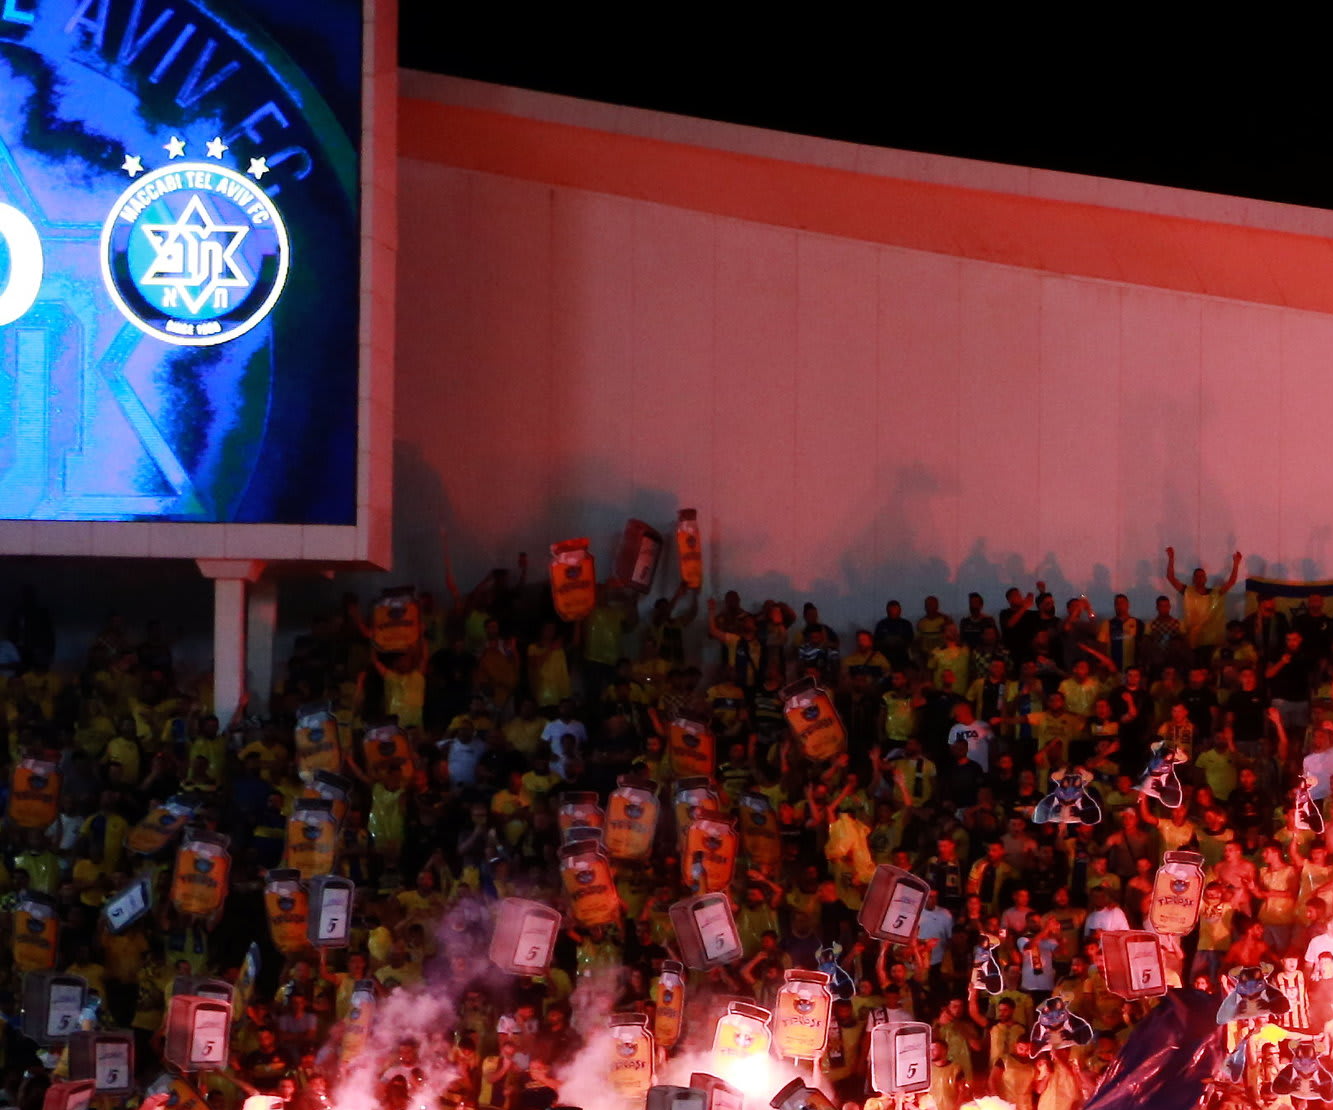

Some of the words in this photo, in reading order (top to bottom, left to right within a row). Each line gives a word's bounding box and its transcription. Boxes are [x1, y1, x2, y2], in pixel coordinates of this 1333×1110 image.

[64, 0, 240, 108] AVIV
[119, 172, 183, 223] MACCABI
[186, 172, 213, 190] TEL
[215, 177, 254, 207] AVIV
[246, 203, 270, 224] FC
[328, 918, 338, 933] 5
[893, 916, 906, 928] 5
[716, 933, 724, 947] 5
[527, 946, 540, 960] 5
[1142, 969, 1151, 983] 5
[60, 1015, 71, 1028] 5
[203, 1041, 214, 1055] 5
[106, 1070, 117, 1083] 5
[907, 1063, 918, 1078] 5
